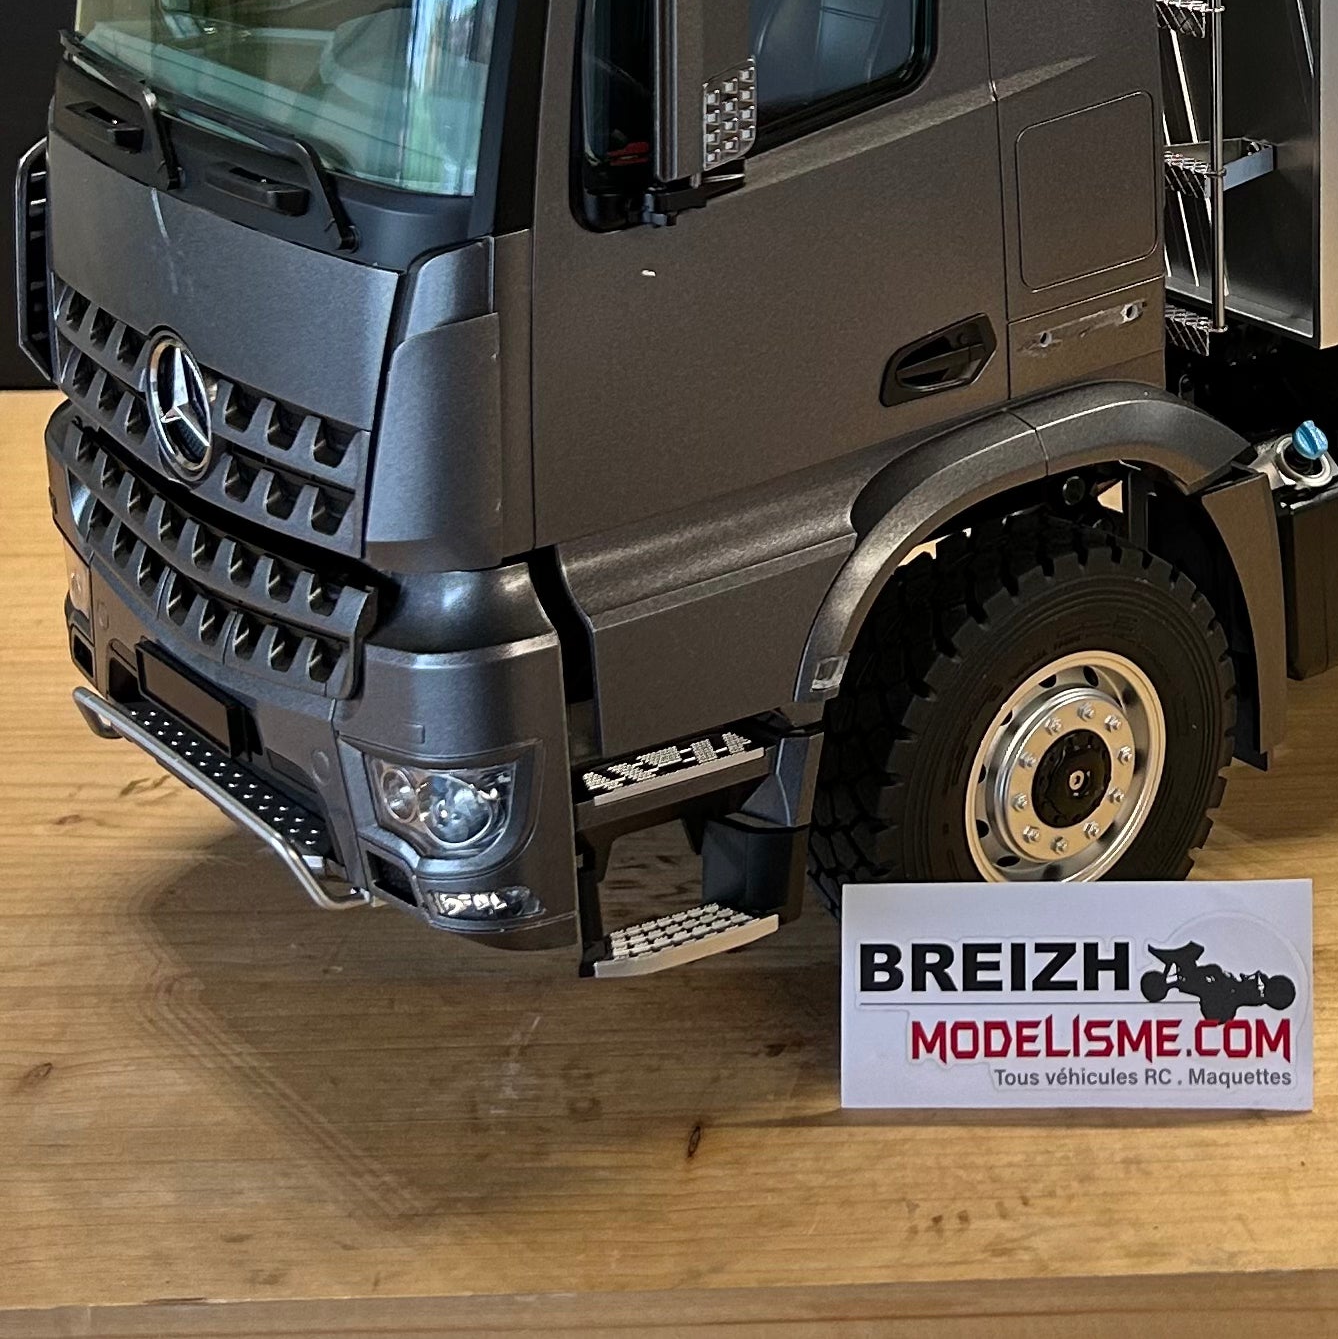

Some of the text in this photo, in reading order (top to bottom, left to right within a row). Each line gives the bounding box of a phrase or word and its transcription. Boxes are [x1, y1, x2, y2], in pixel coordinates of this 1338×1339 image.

[859, 942, 1130, 992] BREIZH
[911, 1014, 1291, 1065] MODELISME.COM
[994, 1069, 1039, 1086] Tous
[1045, 1067, 1138, 1086] véhicules
[1145, 1068, 1172, 1085] RC
[1188, 1067, 1292, 1089] Maquettes
